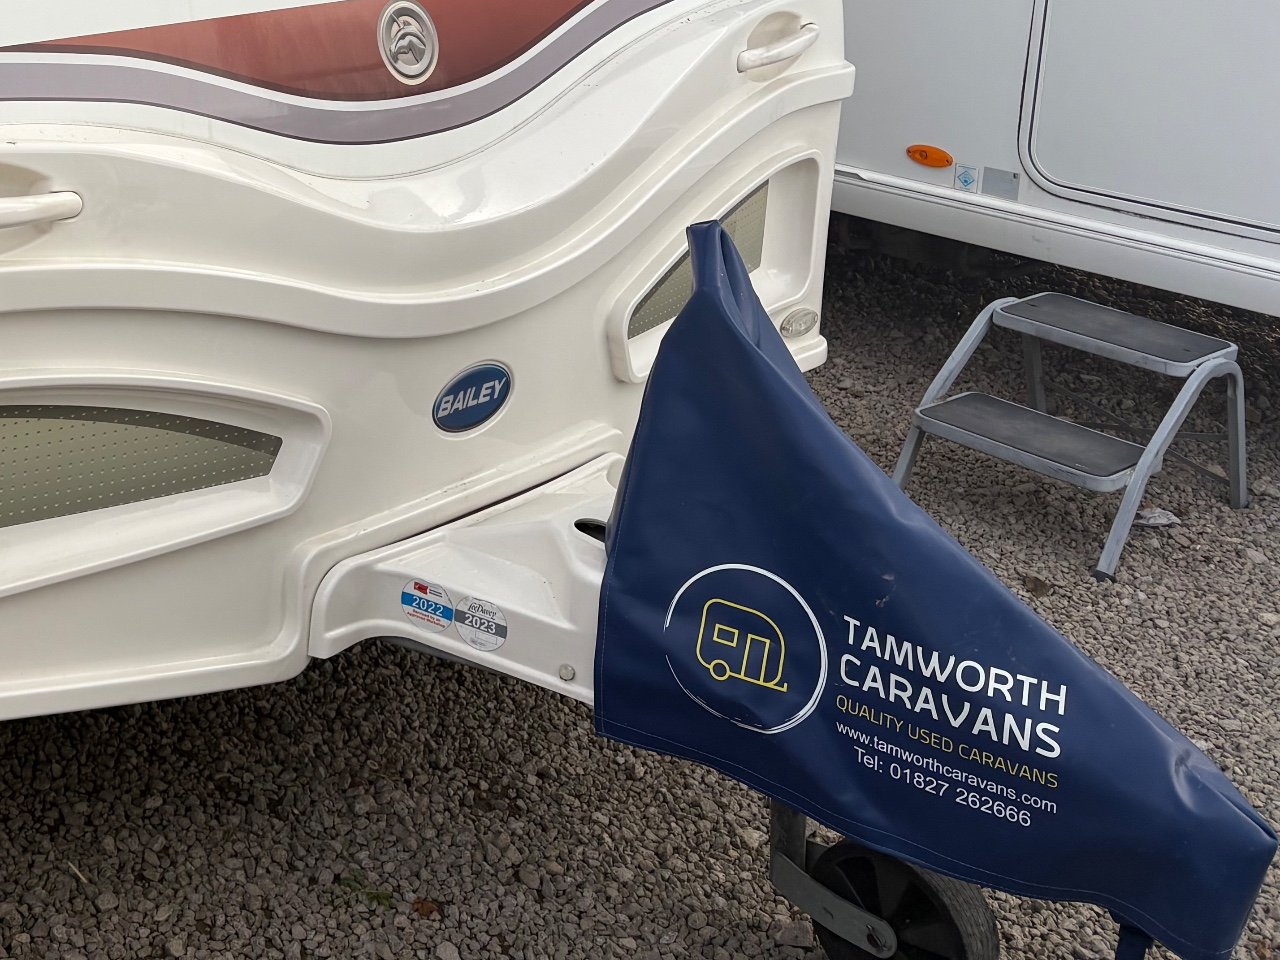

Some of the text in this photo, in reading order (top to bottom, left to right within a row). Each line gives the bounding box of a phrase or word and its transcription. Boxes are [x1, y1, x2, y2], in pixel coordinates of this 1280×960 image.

[437, 377, 507, 418] BAILEY
[412, 596, 444, 617] 2022
[464, 613, 496, 634] 2023
[839, 653, 1061, 759] CARAVANS
[843, 614, 1067, 716] TAMWORTH
[836, 694, 1059, 788] QUALITY USED CARAVANS
[836, 721, 1057, 814] www.tamworthcaravans.com
[853, 745, 1031, 827] Tel: 01827 262666
